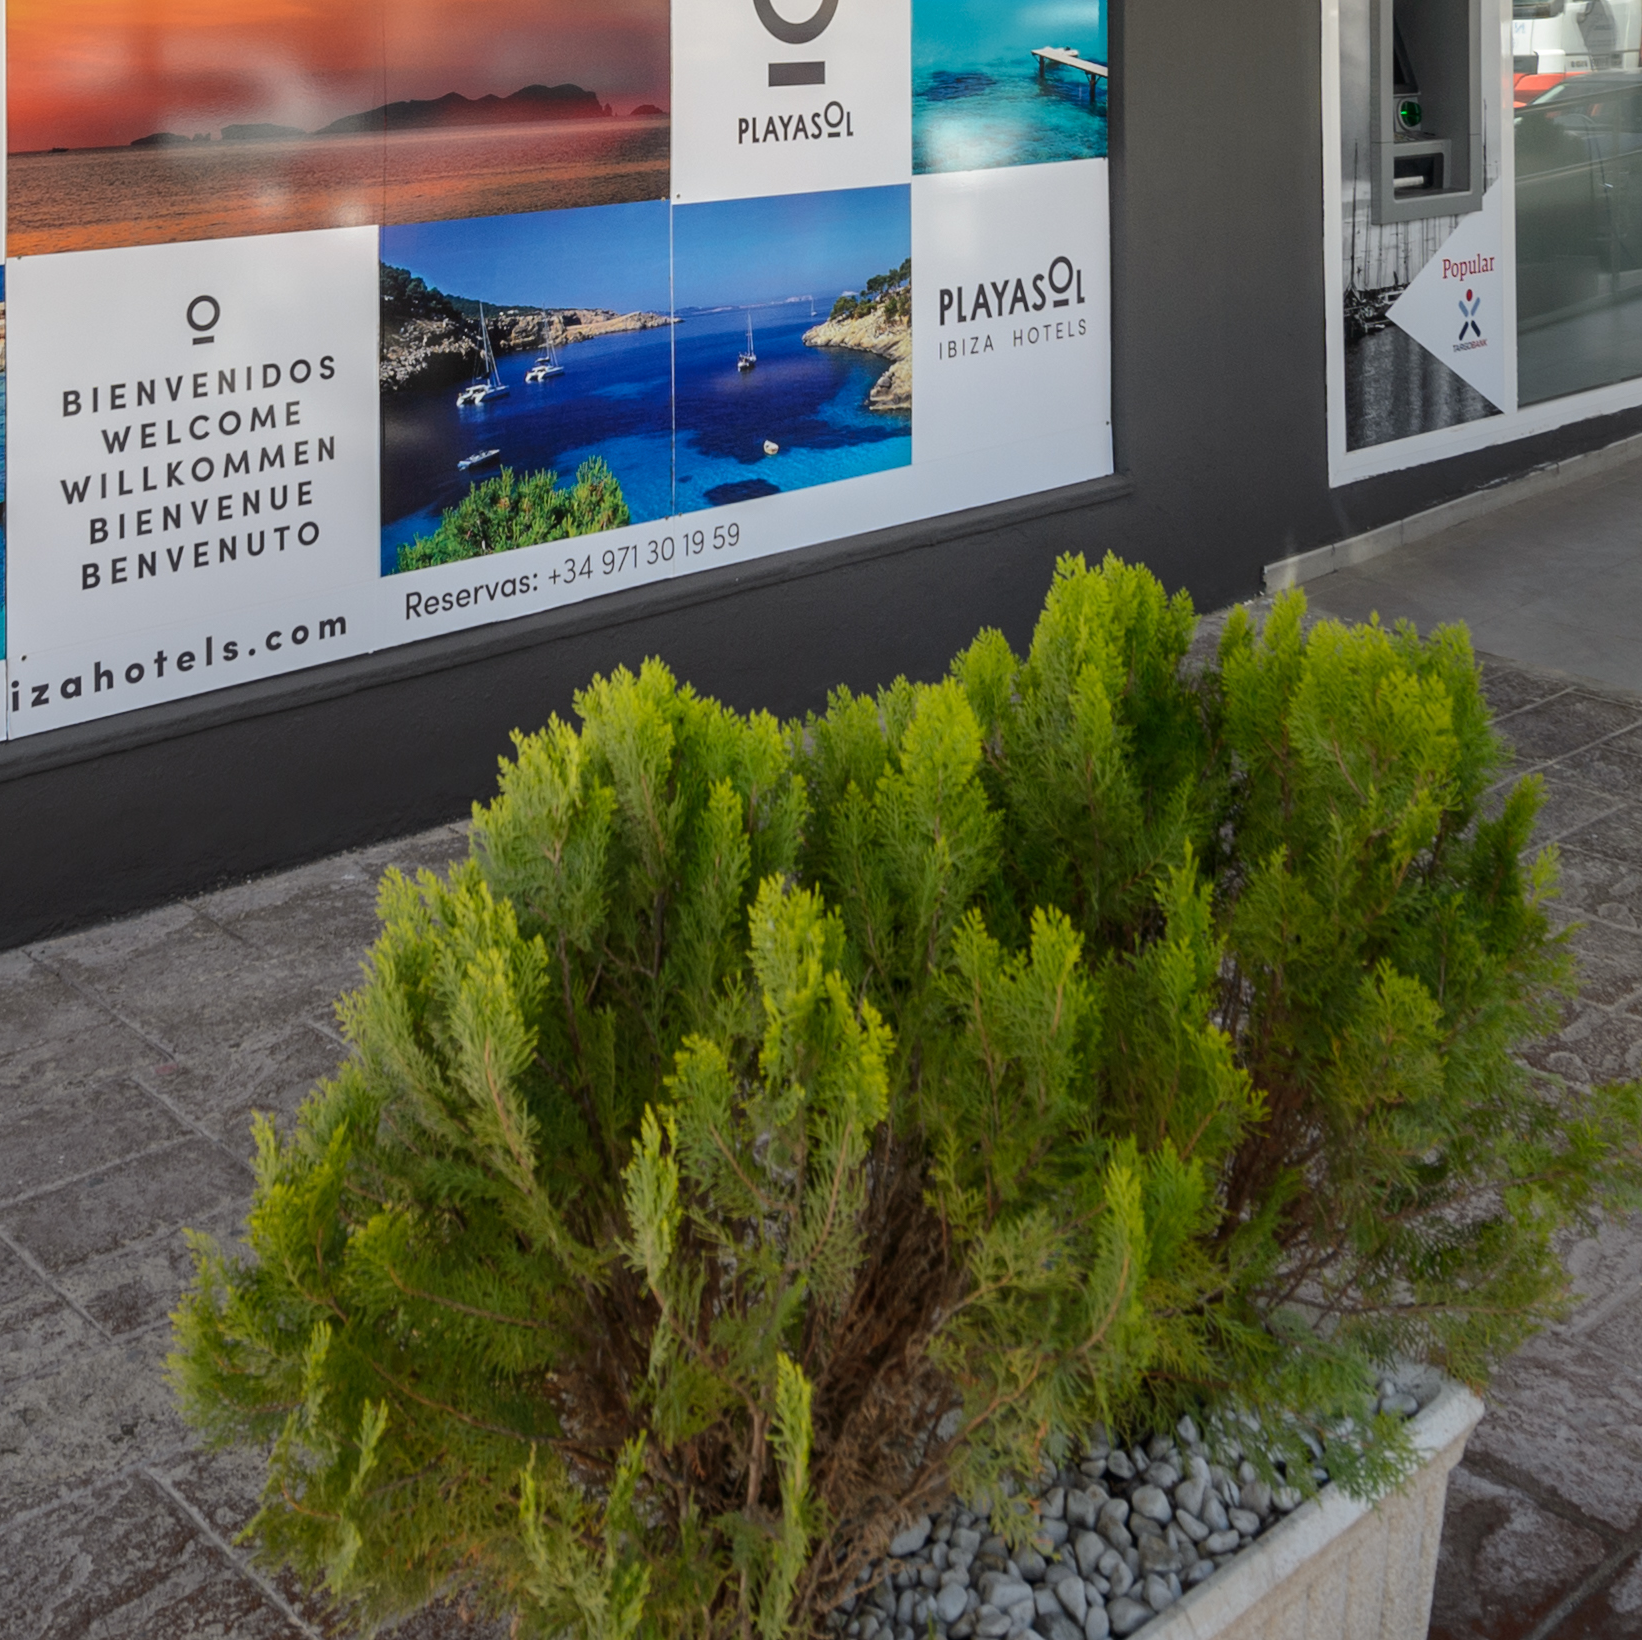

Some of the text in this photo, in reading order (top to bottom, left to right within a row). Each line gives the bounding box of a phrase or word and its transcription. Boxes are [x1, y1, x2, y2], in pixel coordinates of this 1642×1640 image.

[738, 100, 854, 145] PLAYASOL
[939, 255, 1086, 326] PLAYASOL
[1442, 253, 1495, 282] Popular
[939, 318, 1087, 360] IBIZA HOTELS
[62, 355, 335, 417] BIENVENIDOS
[101, 400, 301, 454] WELCOME
[60, 436, 336, 505] WILLKOMMEN
[90, 480, 313, 545] BIENVENUE
[81, 520, 320, 590] BENVENUTO
[405, 522, 741, 620] Reservas: +34 971 30 19 59
